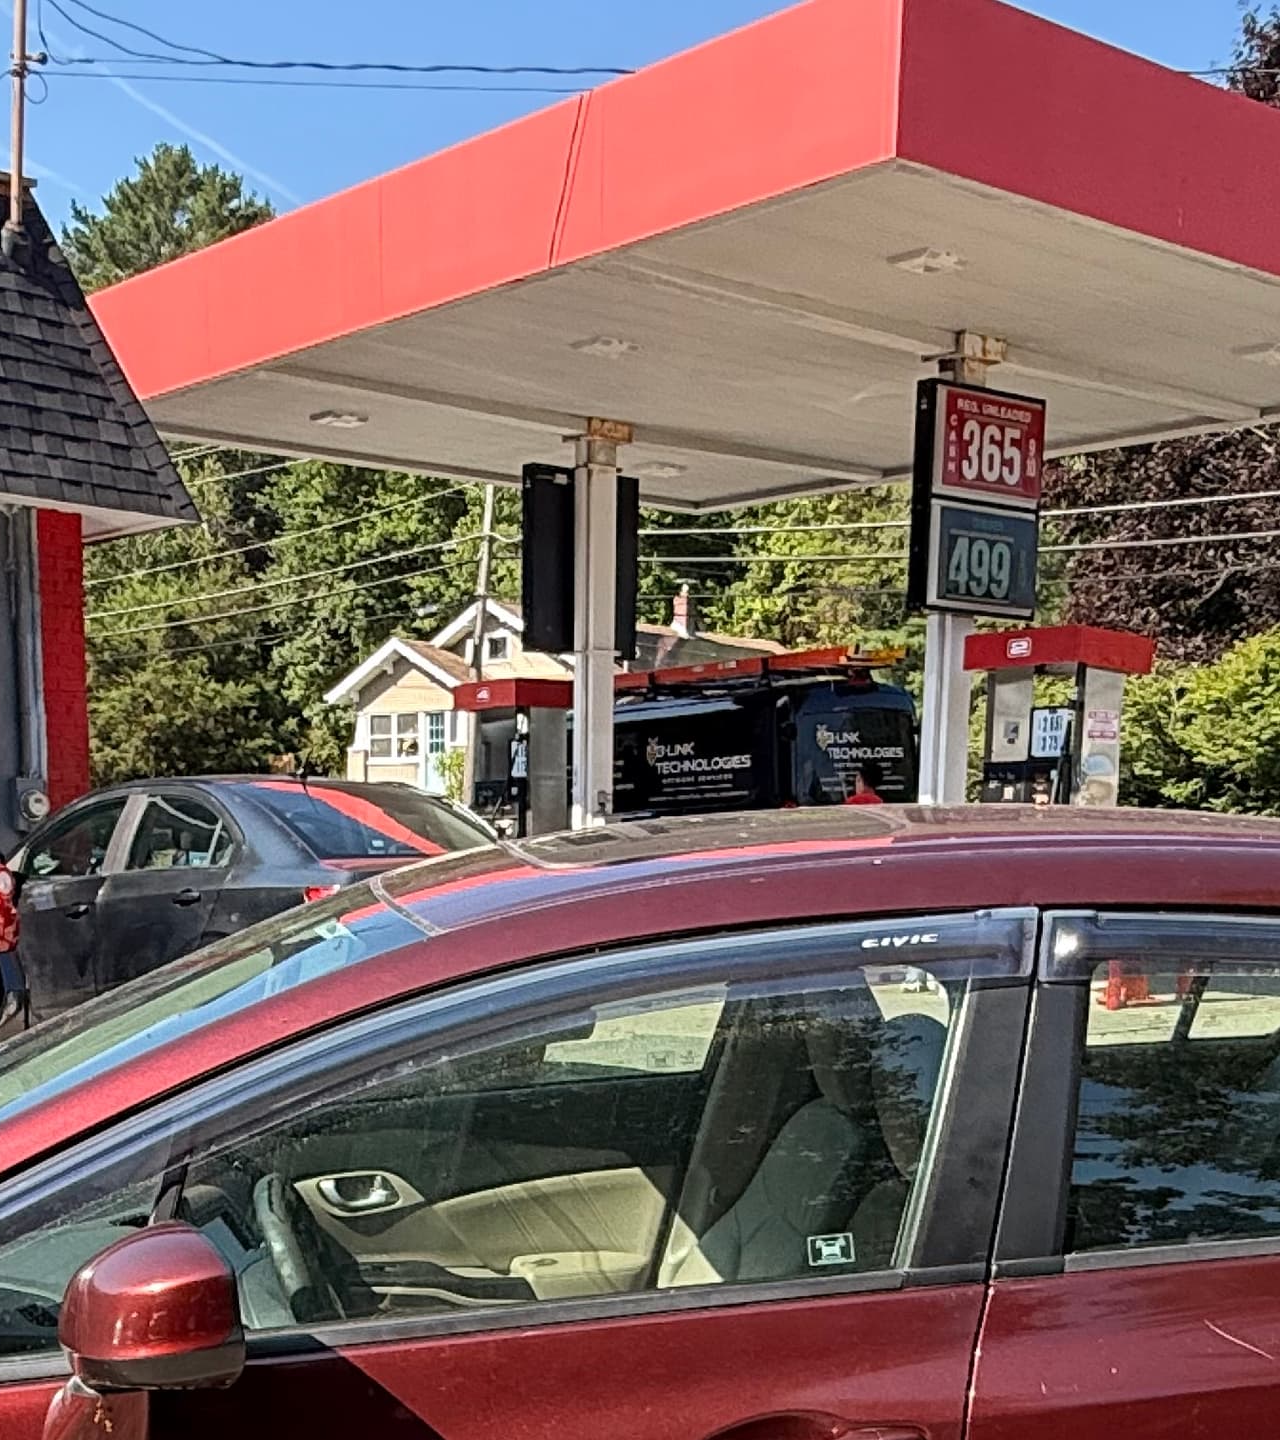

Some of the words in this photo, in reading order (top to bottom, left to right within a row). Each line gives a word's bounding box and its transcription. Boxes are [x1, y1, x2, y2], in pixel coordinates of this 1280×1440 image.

[962, 420, 1021, 485] 365
[949, 537, 1010, 598] 499
[655, 754, 752, 775] TECHNOLOGIES
[861, 933, 939, 949] CIVIC
